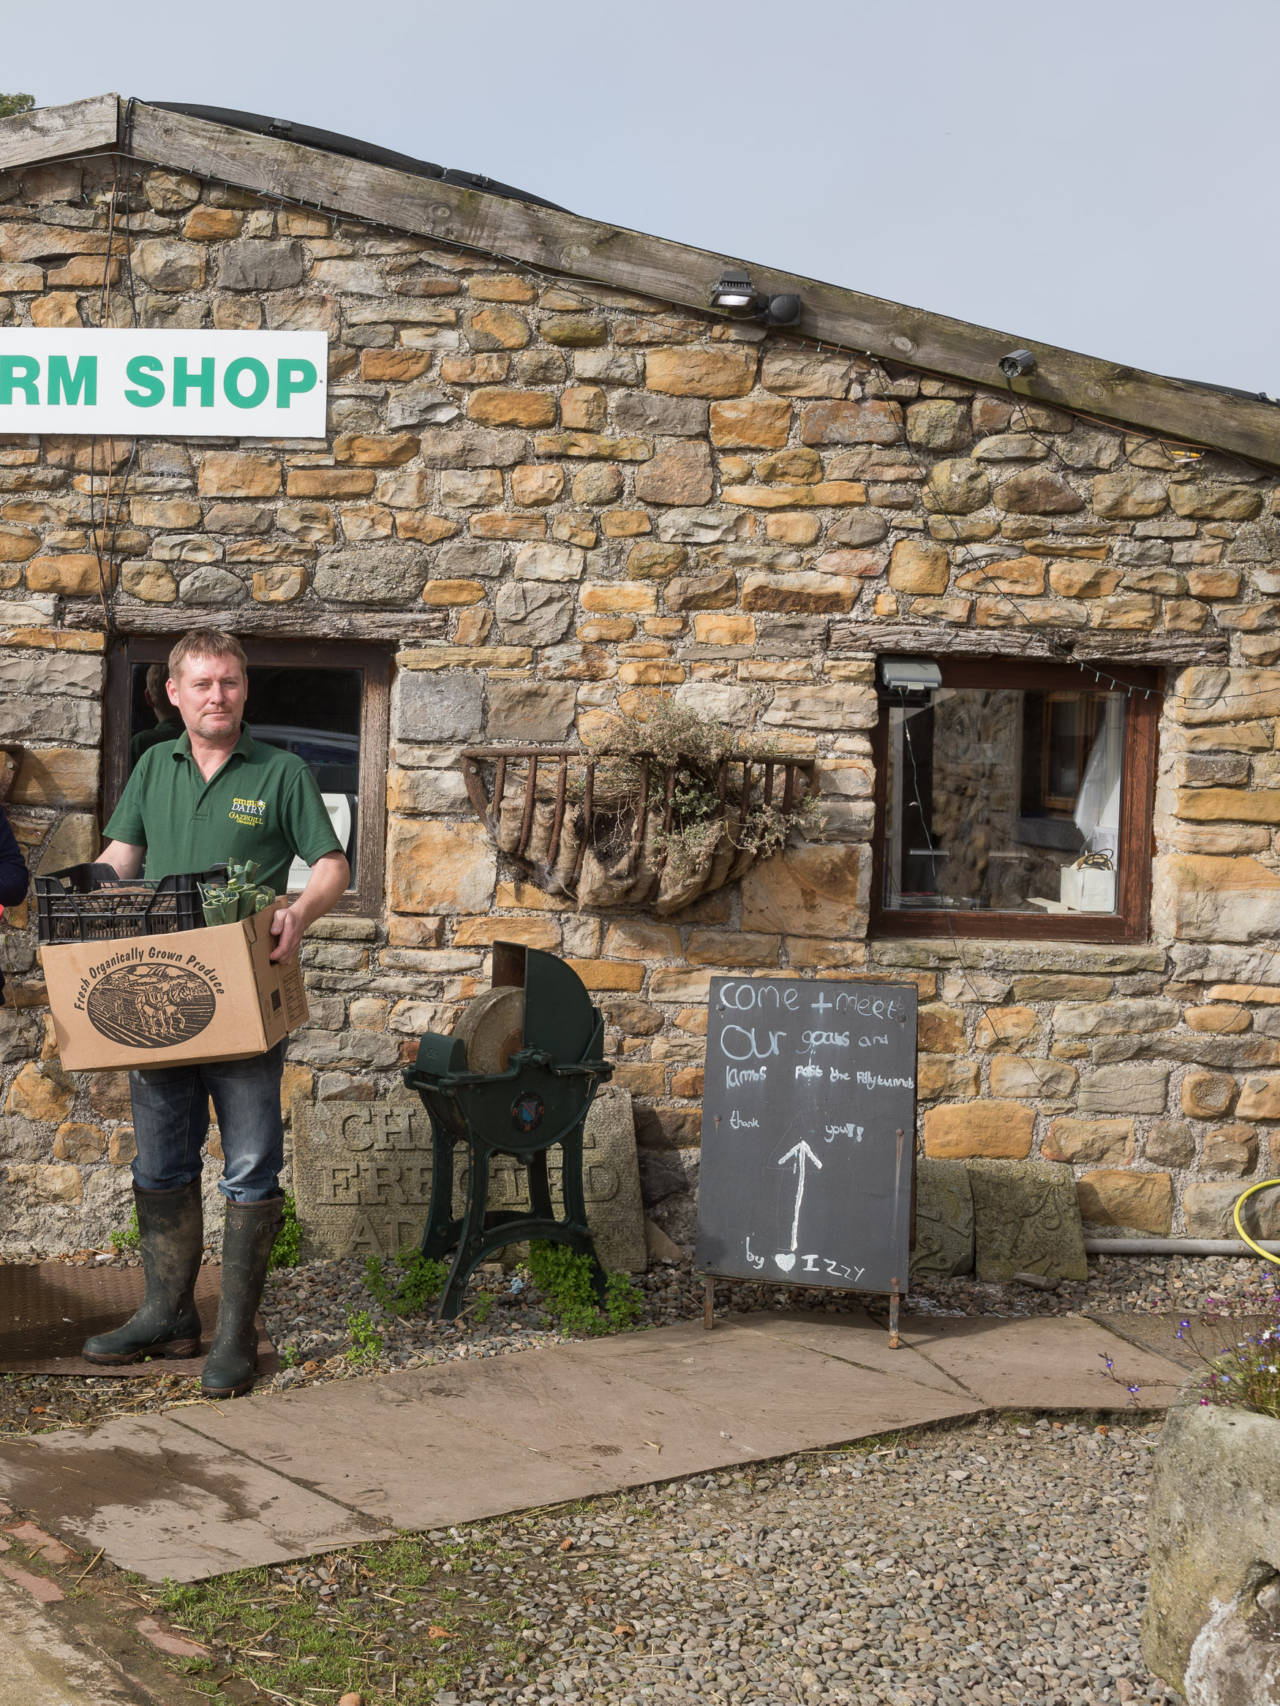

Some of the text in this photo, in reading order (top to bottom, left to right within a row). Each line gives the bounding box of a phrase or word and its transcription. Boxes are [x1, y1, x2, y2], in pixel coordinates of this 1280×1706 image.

[123, 354, 318, 410] SHOP
[231, 803, 265, 816] DAIRY
[74, 946, 225, 1012] Fresh Organically Grown Produce
[858, 1034, 889, 1048] and
[830, 1066, 851, 1082] the
[729, 1110, 760, 1130] thank
[745, 1236, 765, 1270] by
